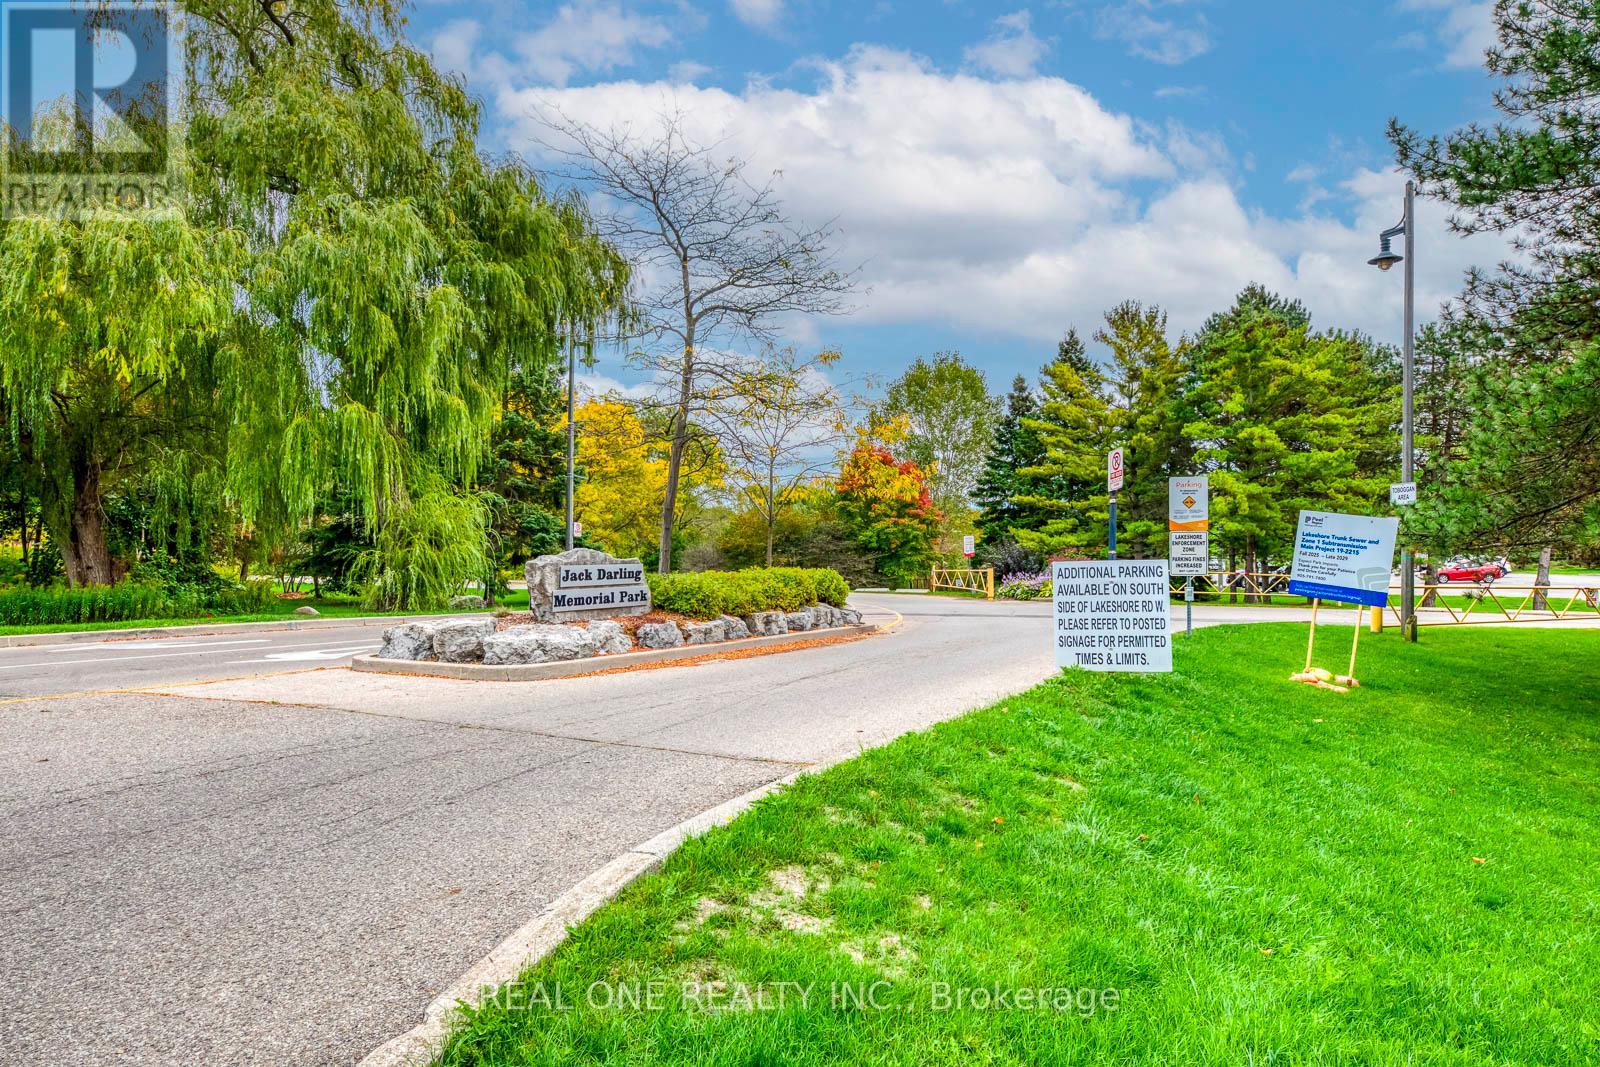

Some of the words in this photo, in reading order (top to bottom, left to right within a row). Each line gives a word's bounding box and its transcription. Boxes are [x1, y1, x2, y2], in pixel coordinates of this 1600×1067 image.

[1302, 531, 1330, 539] Lakeshore
[1322, 540, 1368, 550] Subtransmission
[562, 568, 592, 582] Jack
[597, 568, 642, 582] Darling
[1057, 566, 1116, 579] ADDITIONAL
[1118, 566, 1163, 578] PARKING
[1058, 584, 1110, 596] AVAILABLE
[1112, 584, 1126, 595] ON
[1130, 583, 1164, 595] SOUTH
[554, 592, 615, 608] Memorial
[619, 590, 648, 604] Park
[1058, 601, 1076, 613] SIDE
[1078, 601, 1088, 612] OF
[1090, 600, 1140, 612] LAKESHORE
[1142, 600, 1153, 612] RD
[1155, 600, 1165, 612] W.
[1058, 618, 1088, 630] PLEASE
[1092, 618, 1118, 630] REFER
[1120, 618, 1130, 630] TO
[1133, 618, 1166, 630] POSTED
[1058, 636, 1096, 648] SIGNAGE
[1098, 636, 1116, 648] FOR
[1118, 636, 1166, 648] PERMITTED
[1076, 653, 1104, 665] TIMES
[1106, 653, 1113, 665] &
[1116, 652, 1150, 666] LIMITS.
